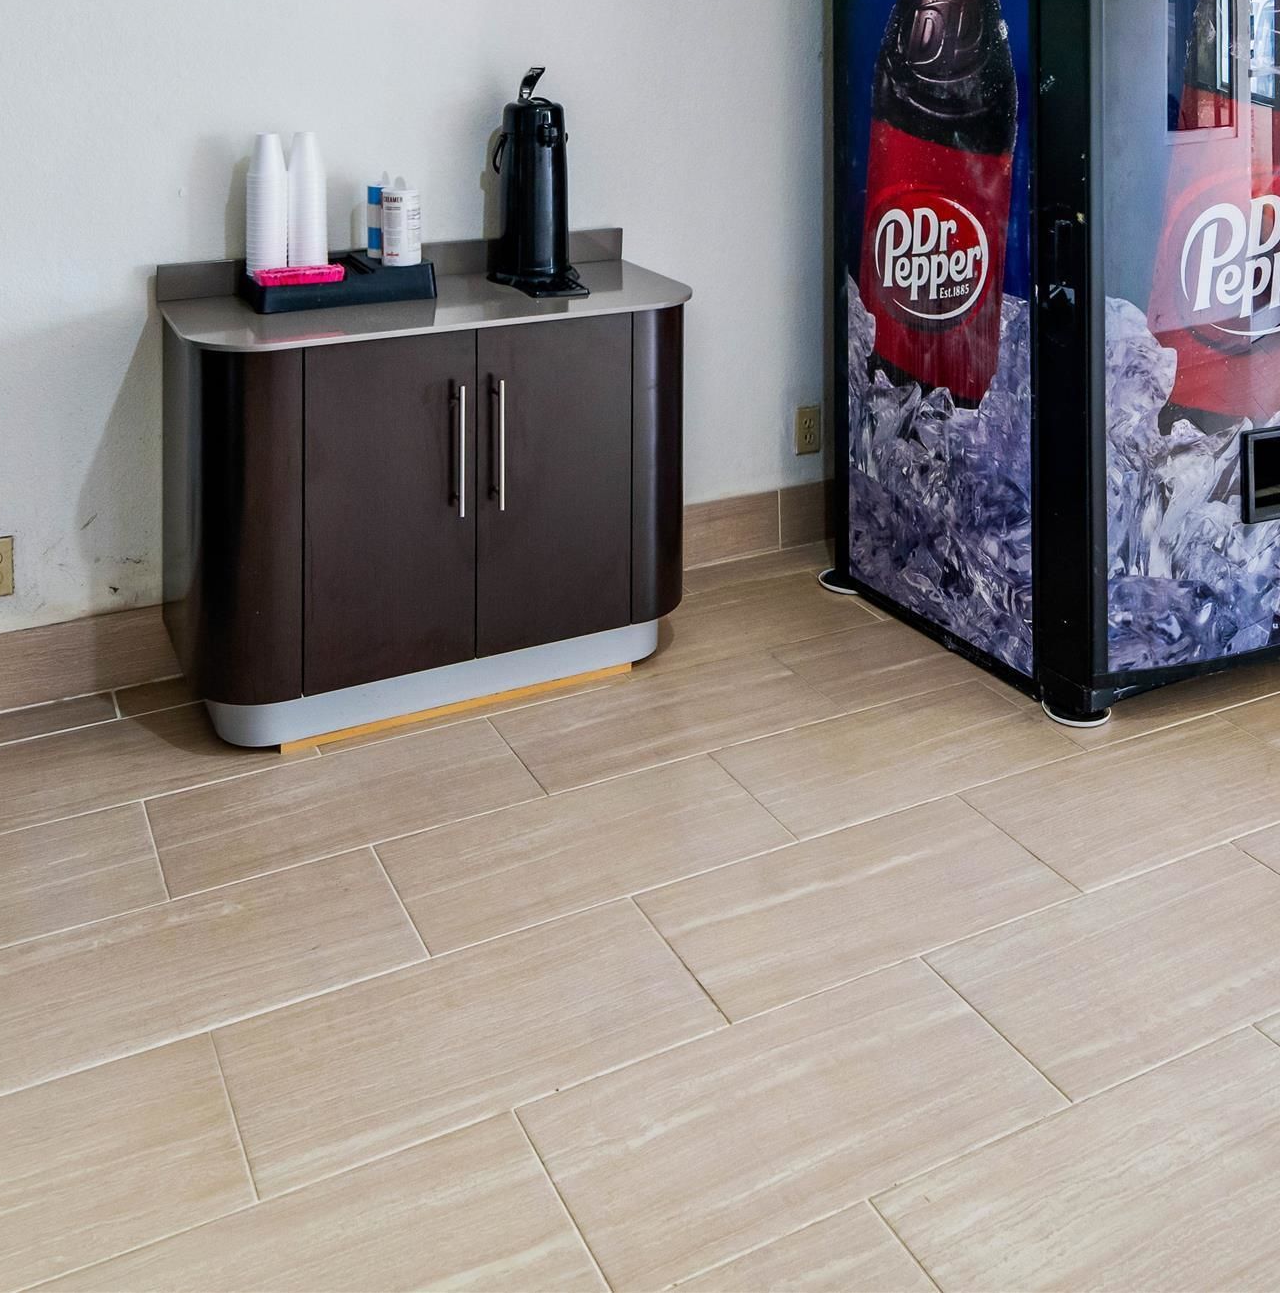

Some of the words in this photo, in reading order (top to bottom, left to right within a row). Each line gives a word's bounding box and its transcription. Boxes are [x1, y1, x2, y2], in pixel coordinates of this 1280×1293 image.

[875, 208, 981, 300] Pepper
[912, 208, 957, 254] Dr
[940, 284, 969, 298] Est.1885
